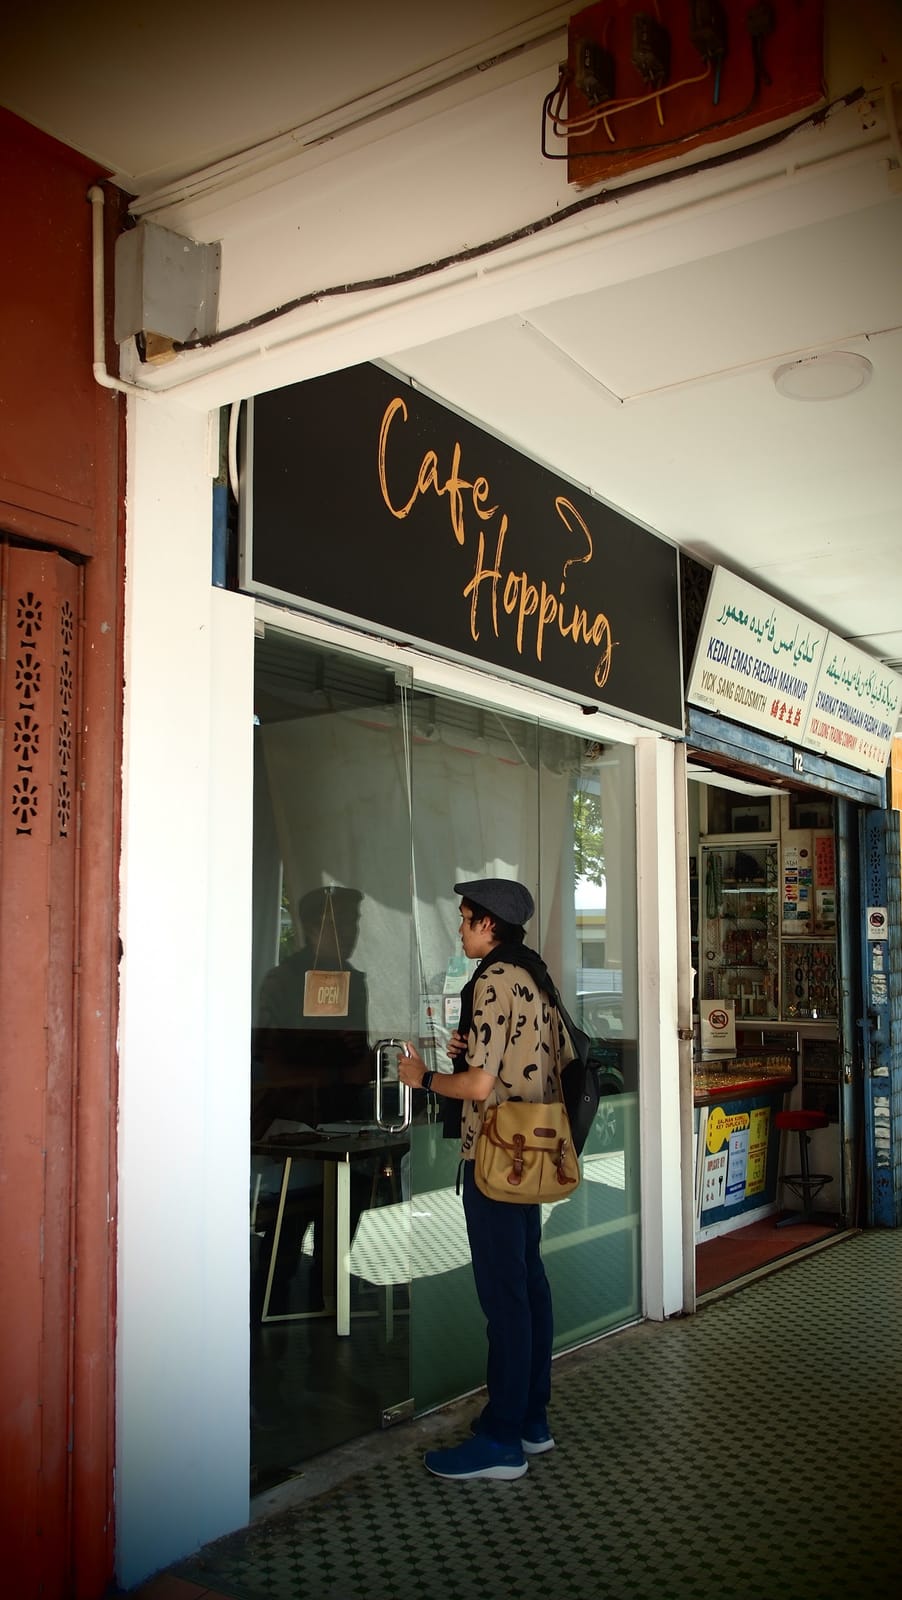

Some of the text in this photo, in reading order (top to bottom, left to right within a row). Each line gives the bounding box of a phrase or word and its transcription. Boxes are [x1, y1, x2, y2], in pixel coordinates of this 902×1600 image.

[378, 397, 500, 545] Cafe
[463, 513, 620, 688] Hopping
[701, 670, 717, 693] YICK
[716, 677, 735, 700] SANG
[734, 684, 767, 712] GOLDSMITH
[706, 637, 808, 701] KEDAI EMAS FAEDAH MAKMUR
[815, 690, 839, 717] SYARIKAT
[317, 985, 340, 1004] OPEN
